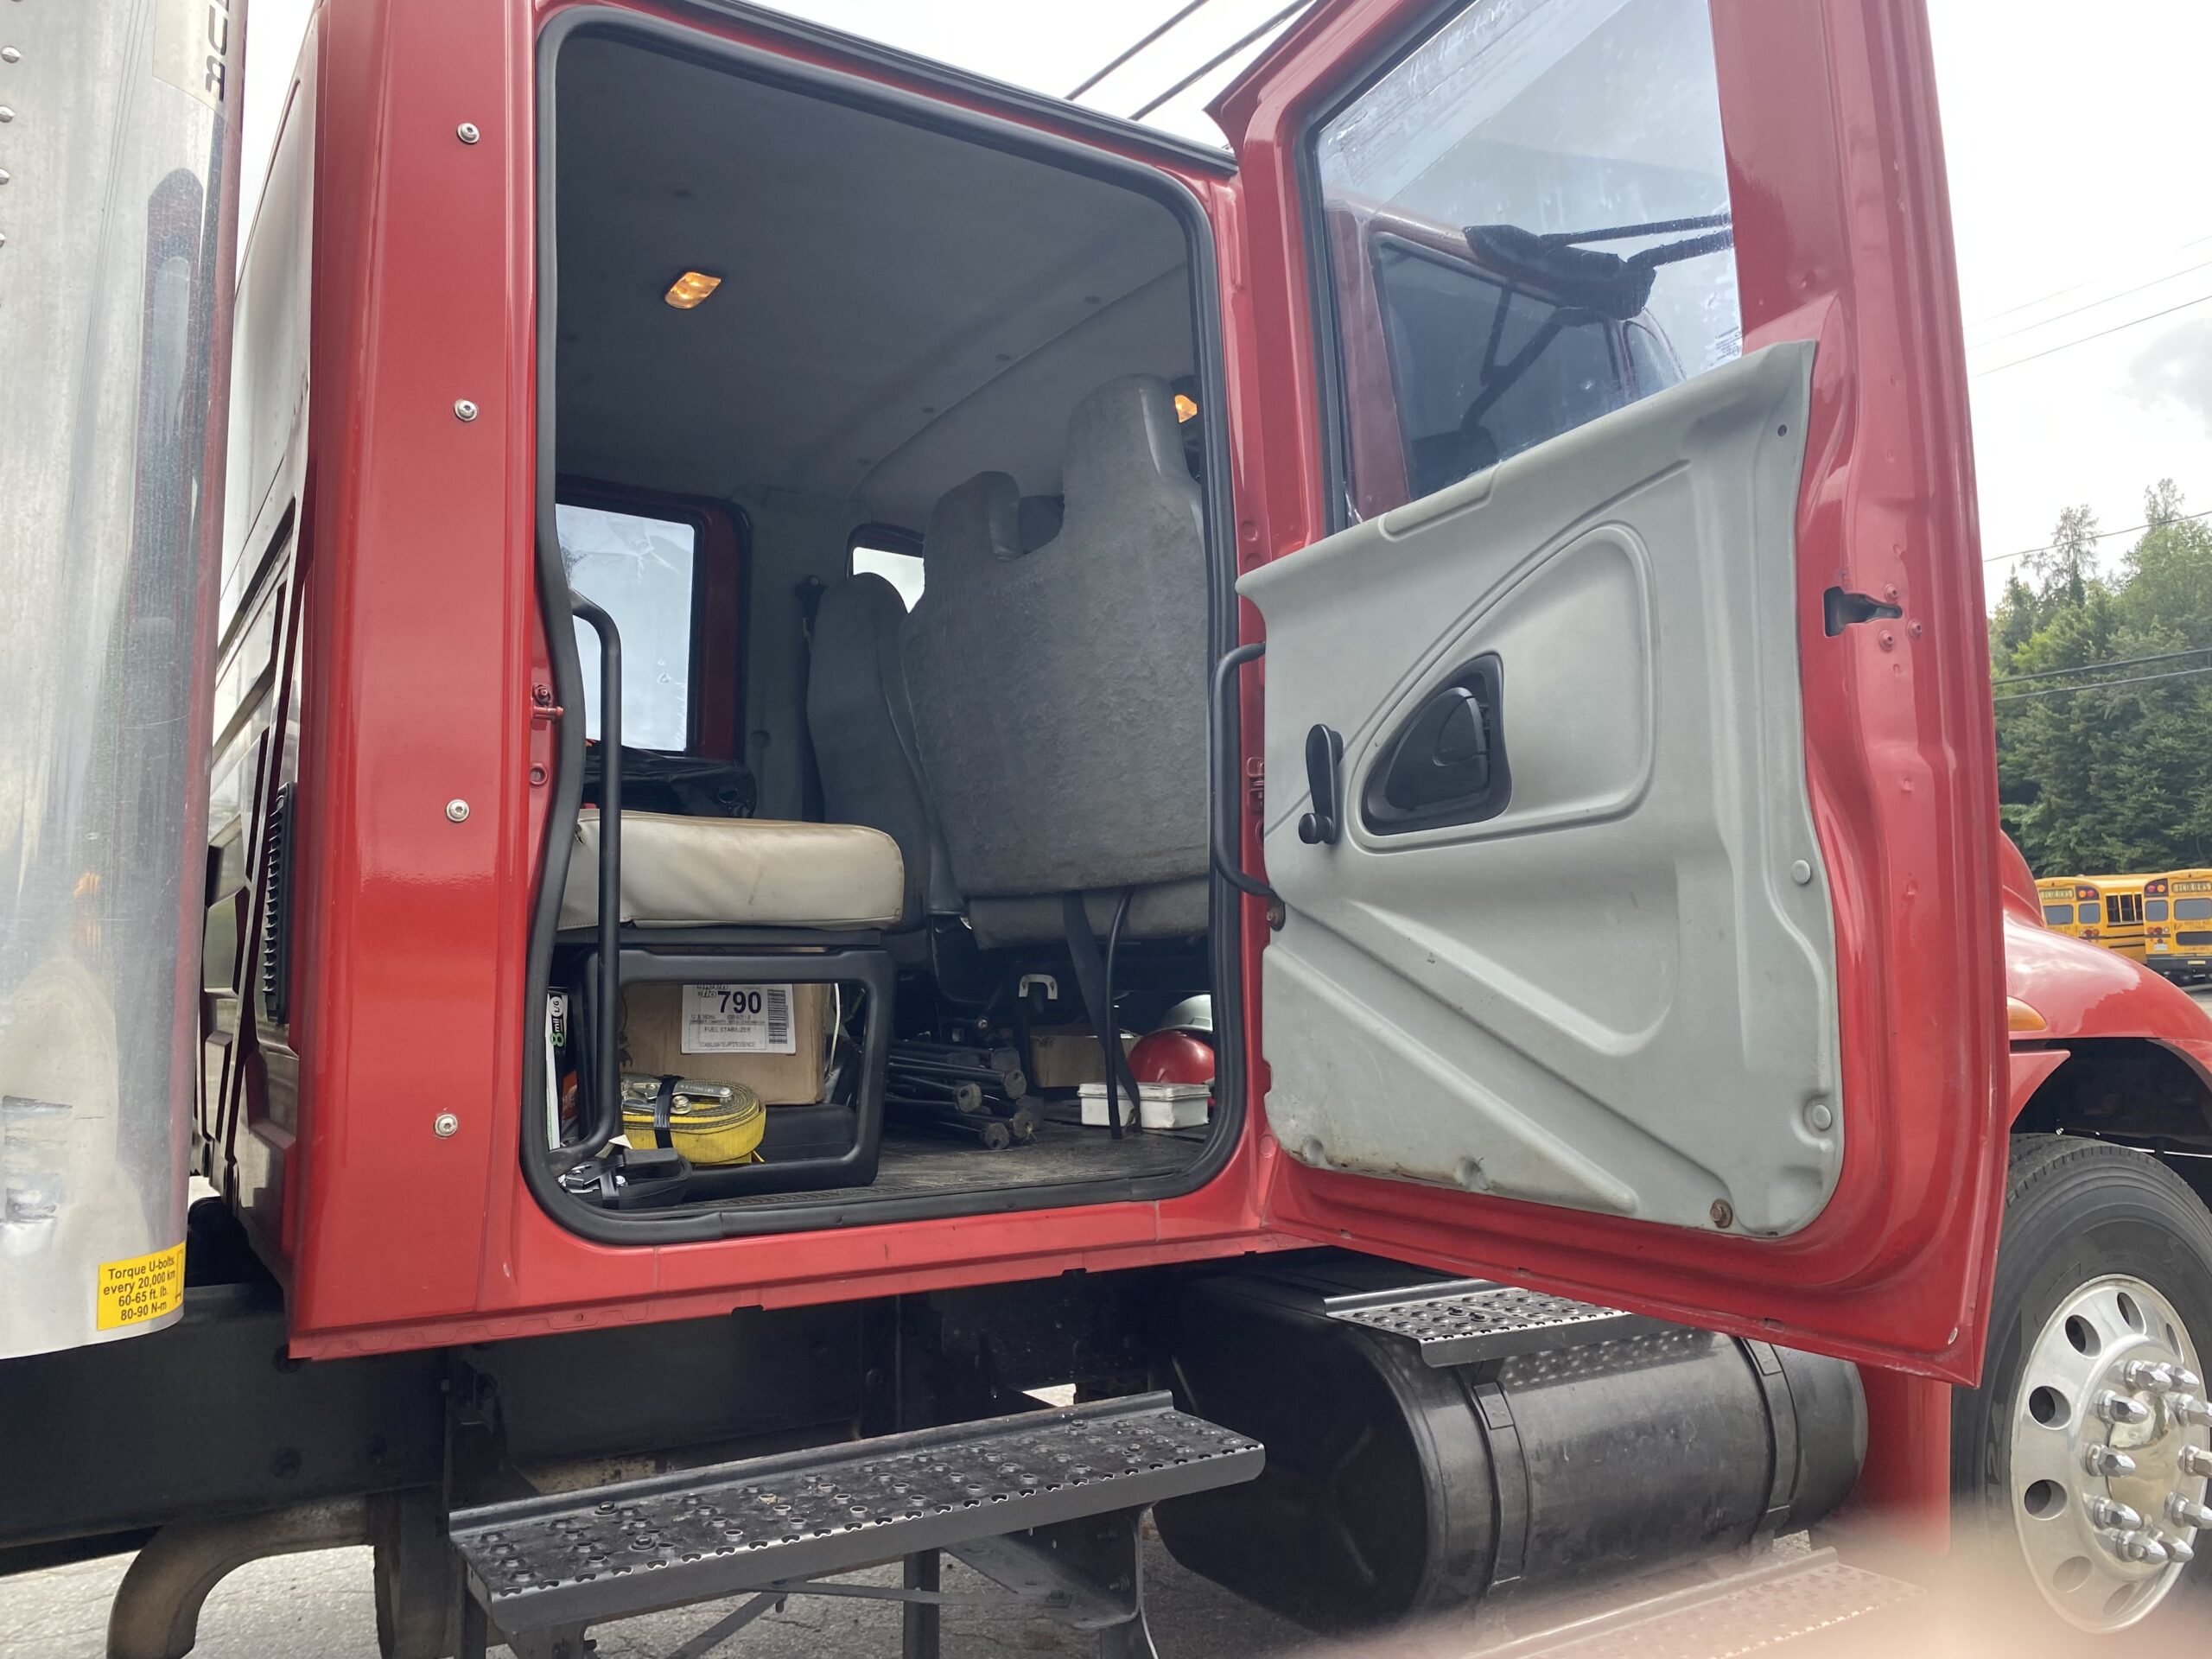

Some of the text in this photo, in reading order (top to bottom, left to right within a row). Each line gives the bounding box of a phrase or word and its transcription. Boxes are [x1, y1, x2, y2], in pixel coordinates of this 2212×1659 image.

[717, 990, 762, 1014] 790
[108, 1256, 175, 1281] Torque U-bolts
[103, 1270, 175, 1296] every 20,000 km
[118, 1292, 147, 1307] 60-65
[149, 1288, 158, 1300] ft.
[121, 1301, 167, 1321] 80-90 N-m
